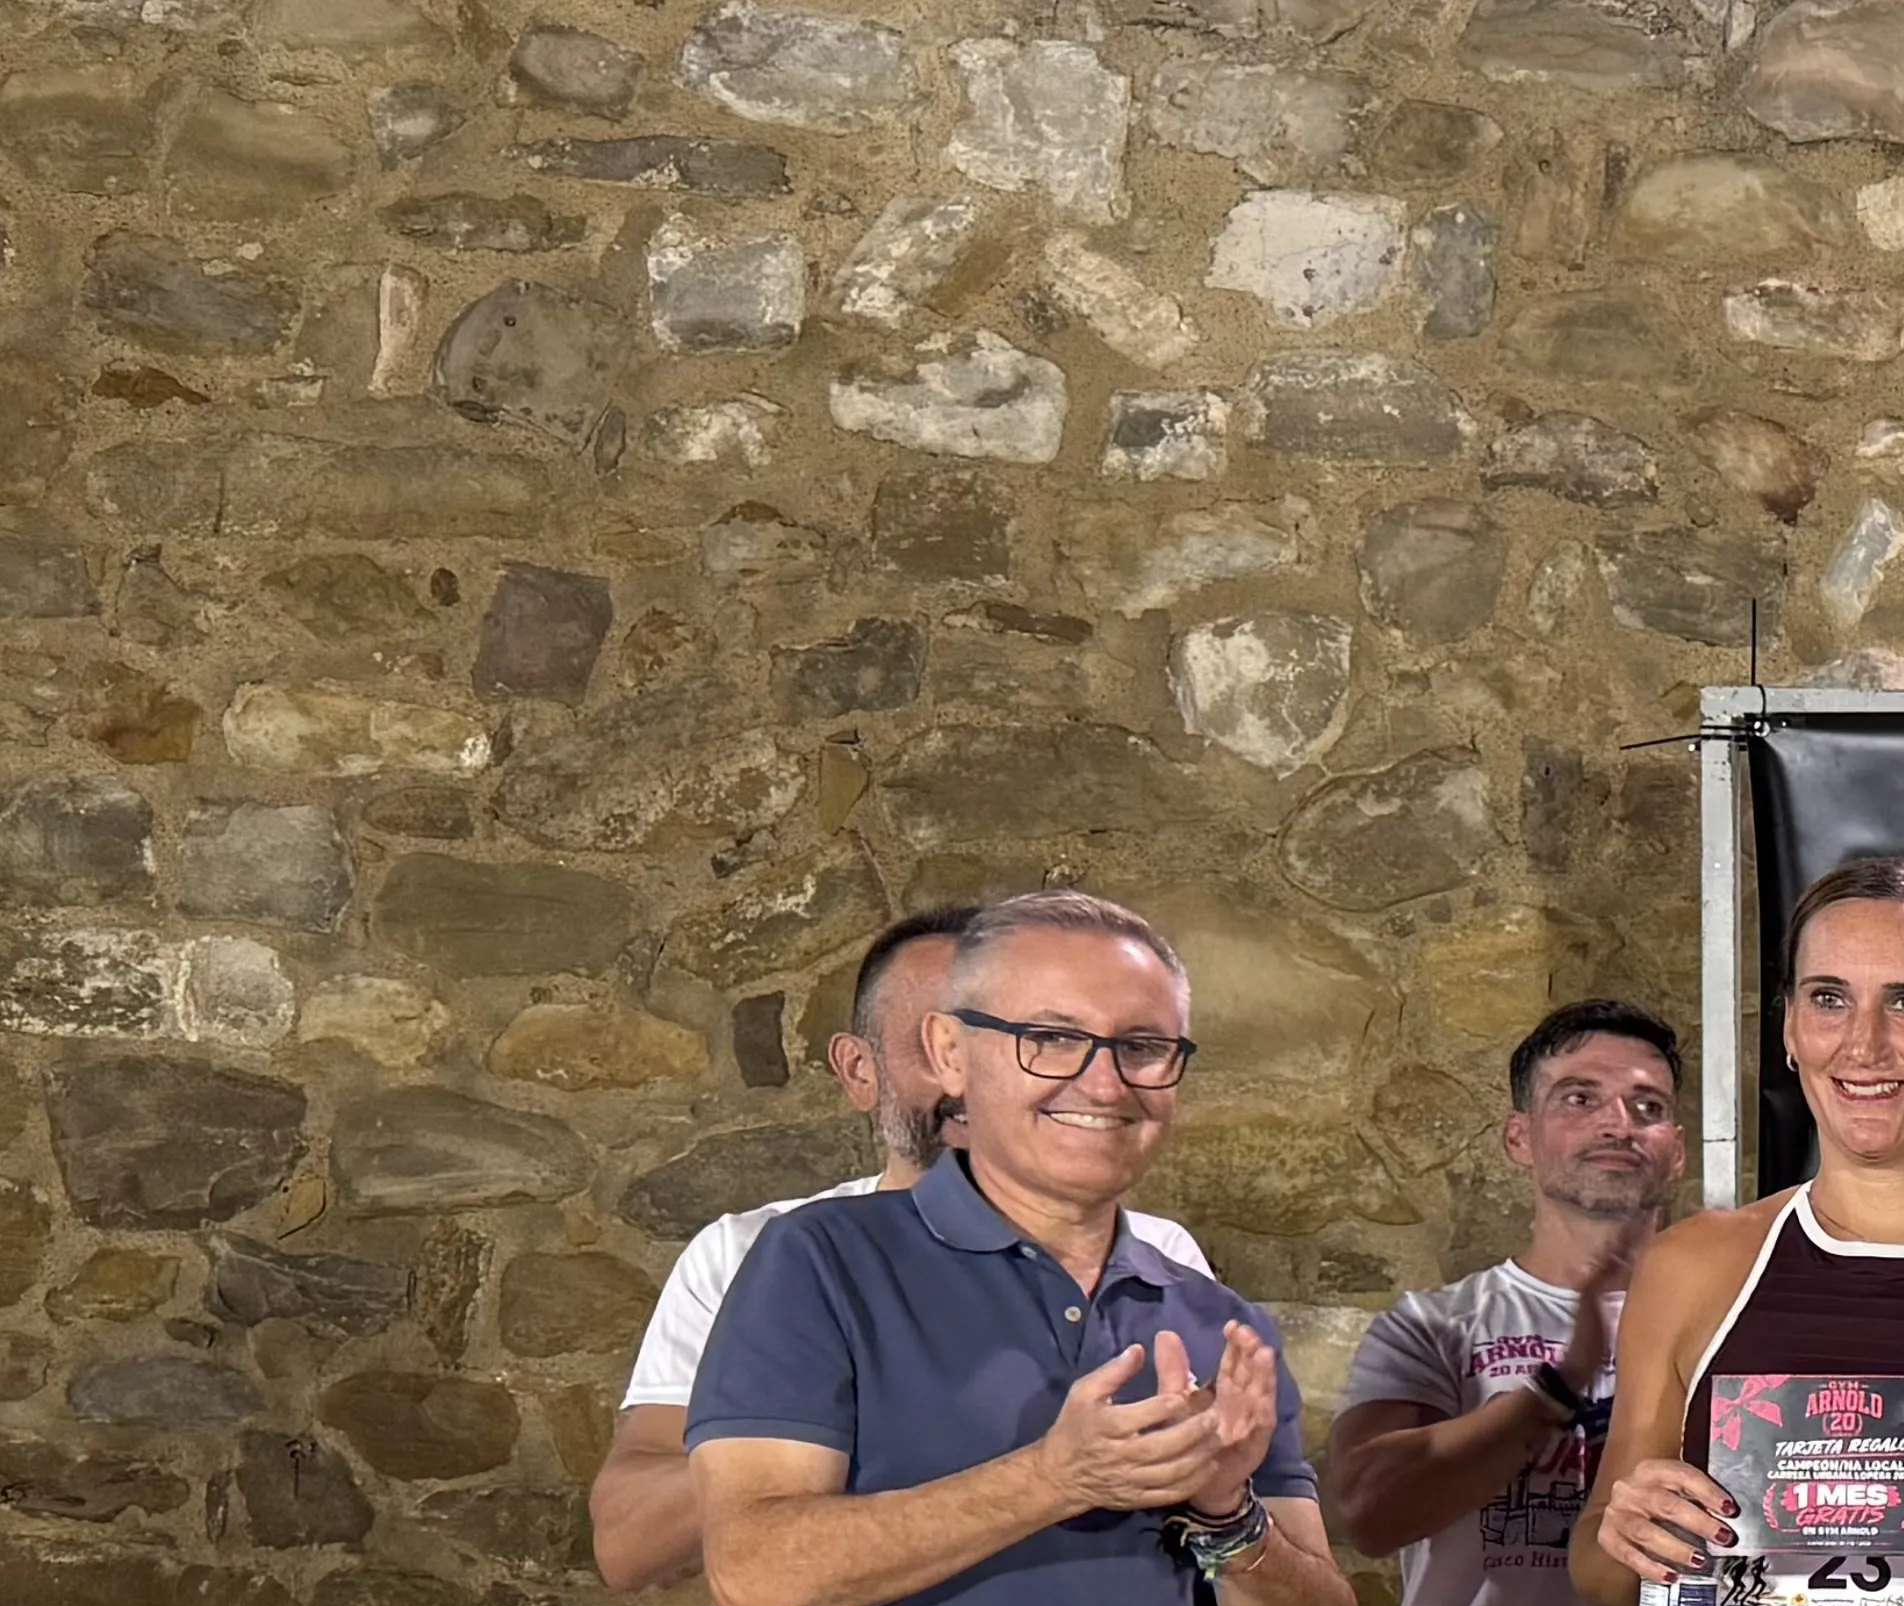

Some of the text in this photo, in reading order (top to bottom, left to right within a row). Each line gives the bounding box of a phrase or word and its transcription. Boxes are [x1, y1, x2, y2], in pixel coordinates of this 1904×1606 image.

[1466, 1341, 1563, 1378] ARNOL
[1805, 1389, 1885, 1419] ARNOLD
[1829, 1413, 1856, 1431] 20
[1775, 1439, 1843, 1457] TARJETA
[1793, 1483, 1888, 1509] 1 MES
[1795, 1506, 1886, 1527] GRATIS
